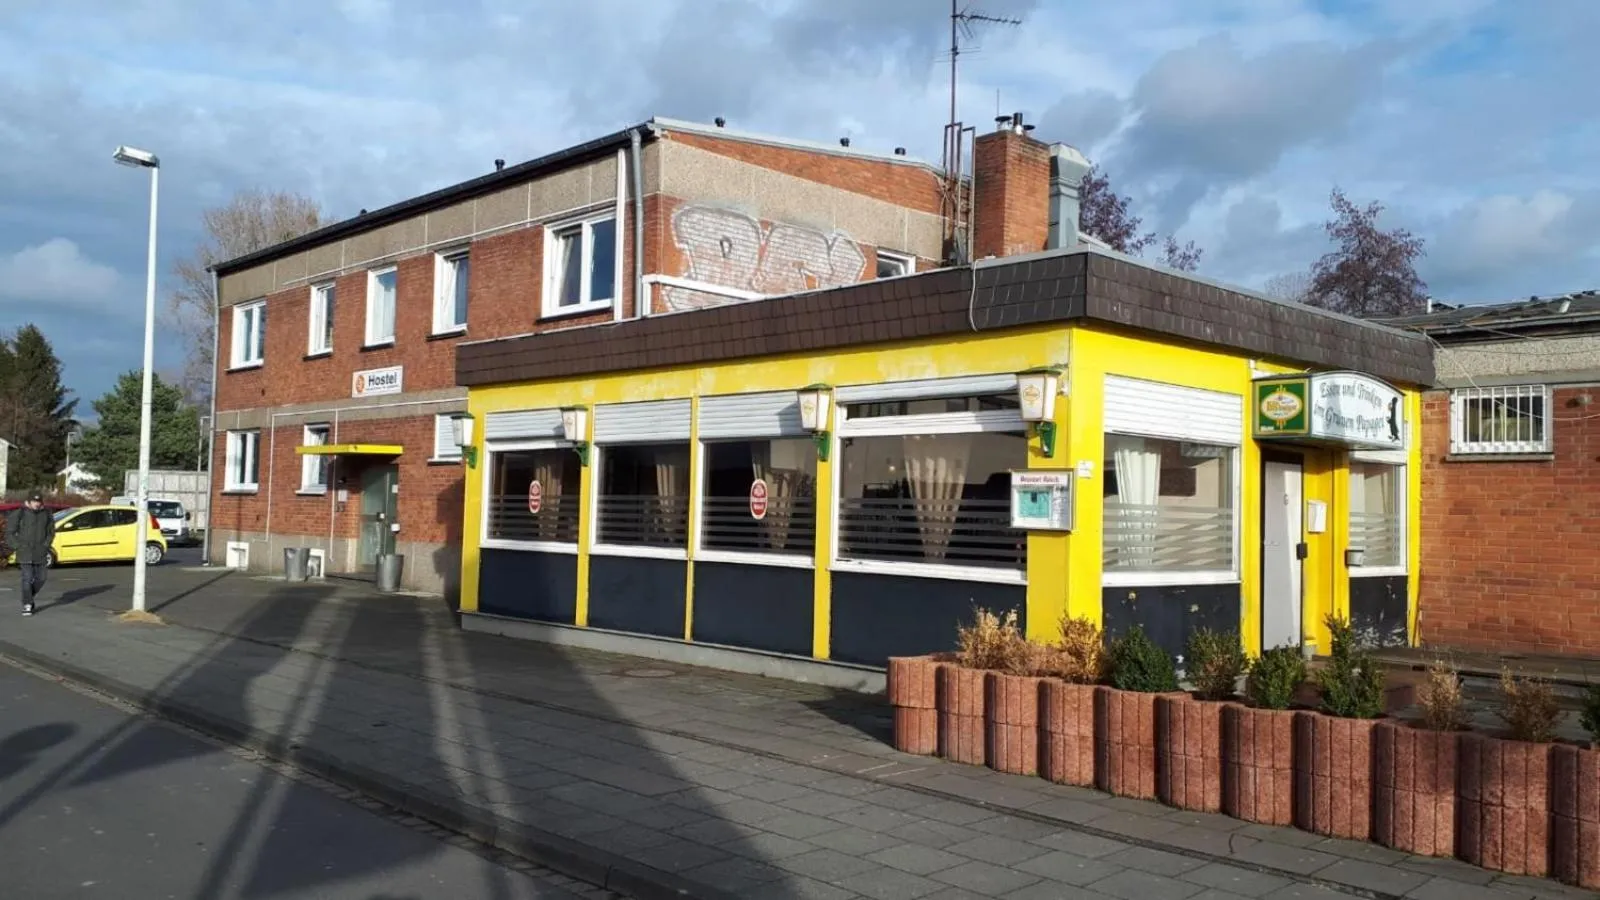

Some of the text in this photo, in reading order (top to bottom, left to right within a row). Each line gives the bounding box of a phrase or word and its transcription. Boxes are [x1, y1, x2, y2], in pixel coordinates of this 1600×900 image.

[368, 371, 397, 387] Hostel
[1320, 380, 1382, 408] Essen und Trinken
